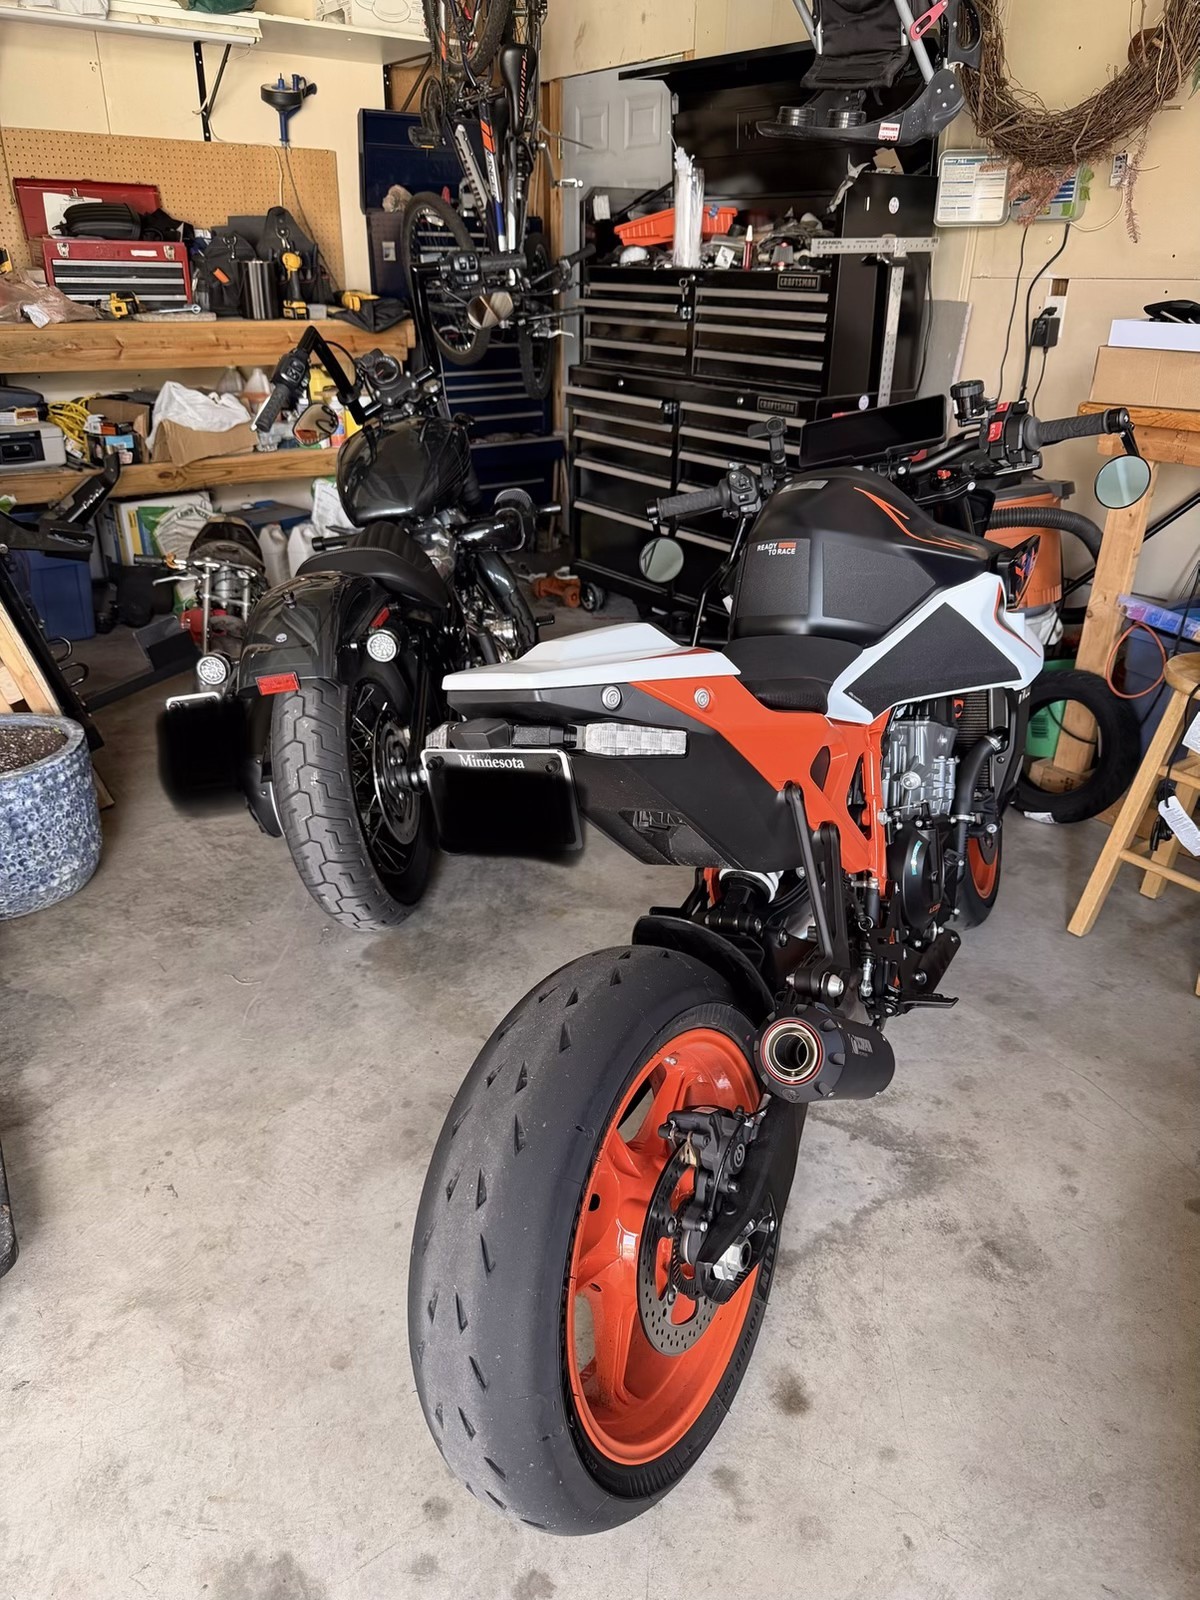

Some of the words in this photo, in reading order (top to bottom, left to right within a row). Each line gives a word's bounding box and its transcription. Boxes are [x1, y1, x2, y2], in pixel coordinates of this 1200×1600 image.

[780, 277, 817, 288] CRAFTSMAN
[760, 400, 795, 413] CRAFTSMAN
[756, 542, 778, 552] READY
[458, 753, 525, 769] Minnesota
